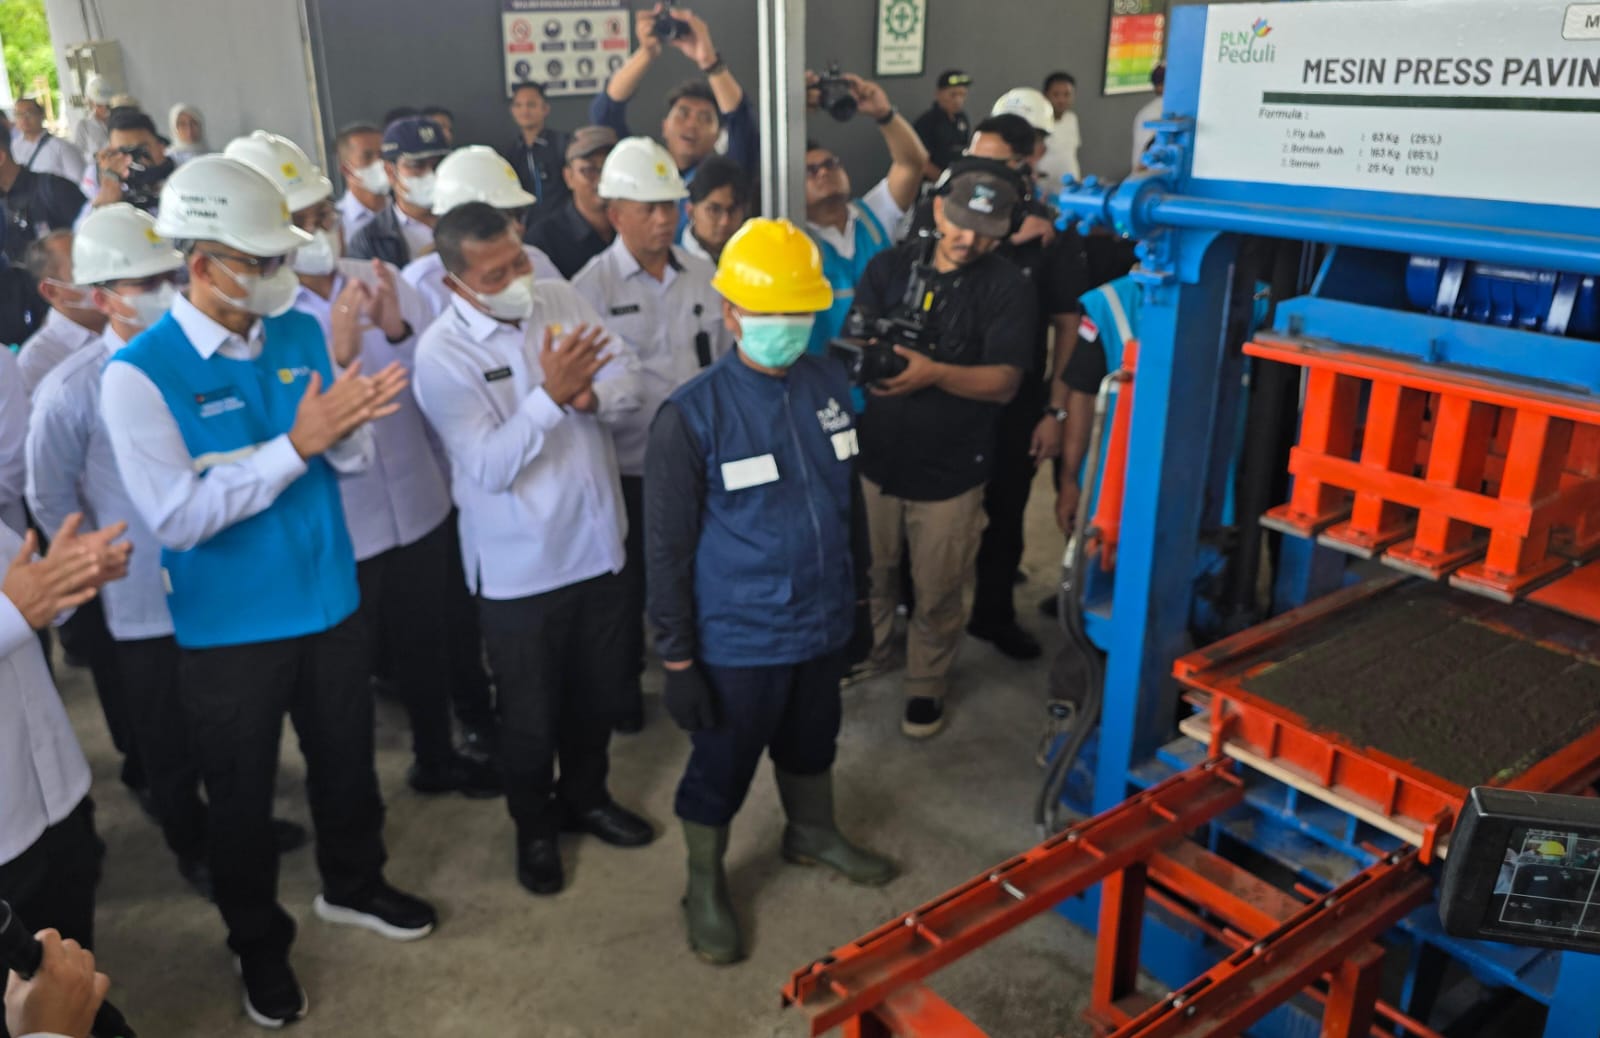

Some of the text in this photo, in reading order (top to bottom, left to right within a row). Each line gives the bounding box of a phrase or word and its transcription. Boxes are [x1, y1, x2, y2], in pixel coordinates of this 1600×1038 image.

[1220, 31, 1249, 46] PLN
[1218, 43, 1277, 63] Peduli
[1302, 58, 1386, 84] MESIN
[1394, 58, 1493, 86] PRESS
